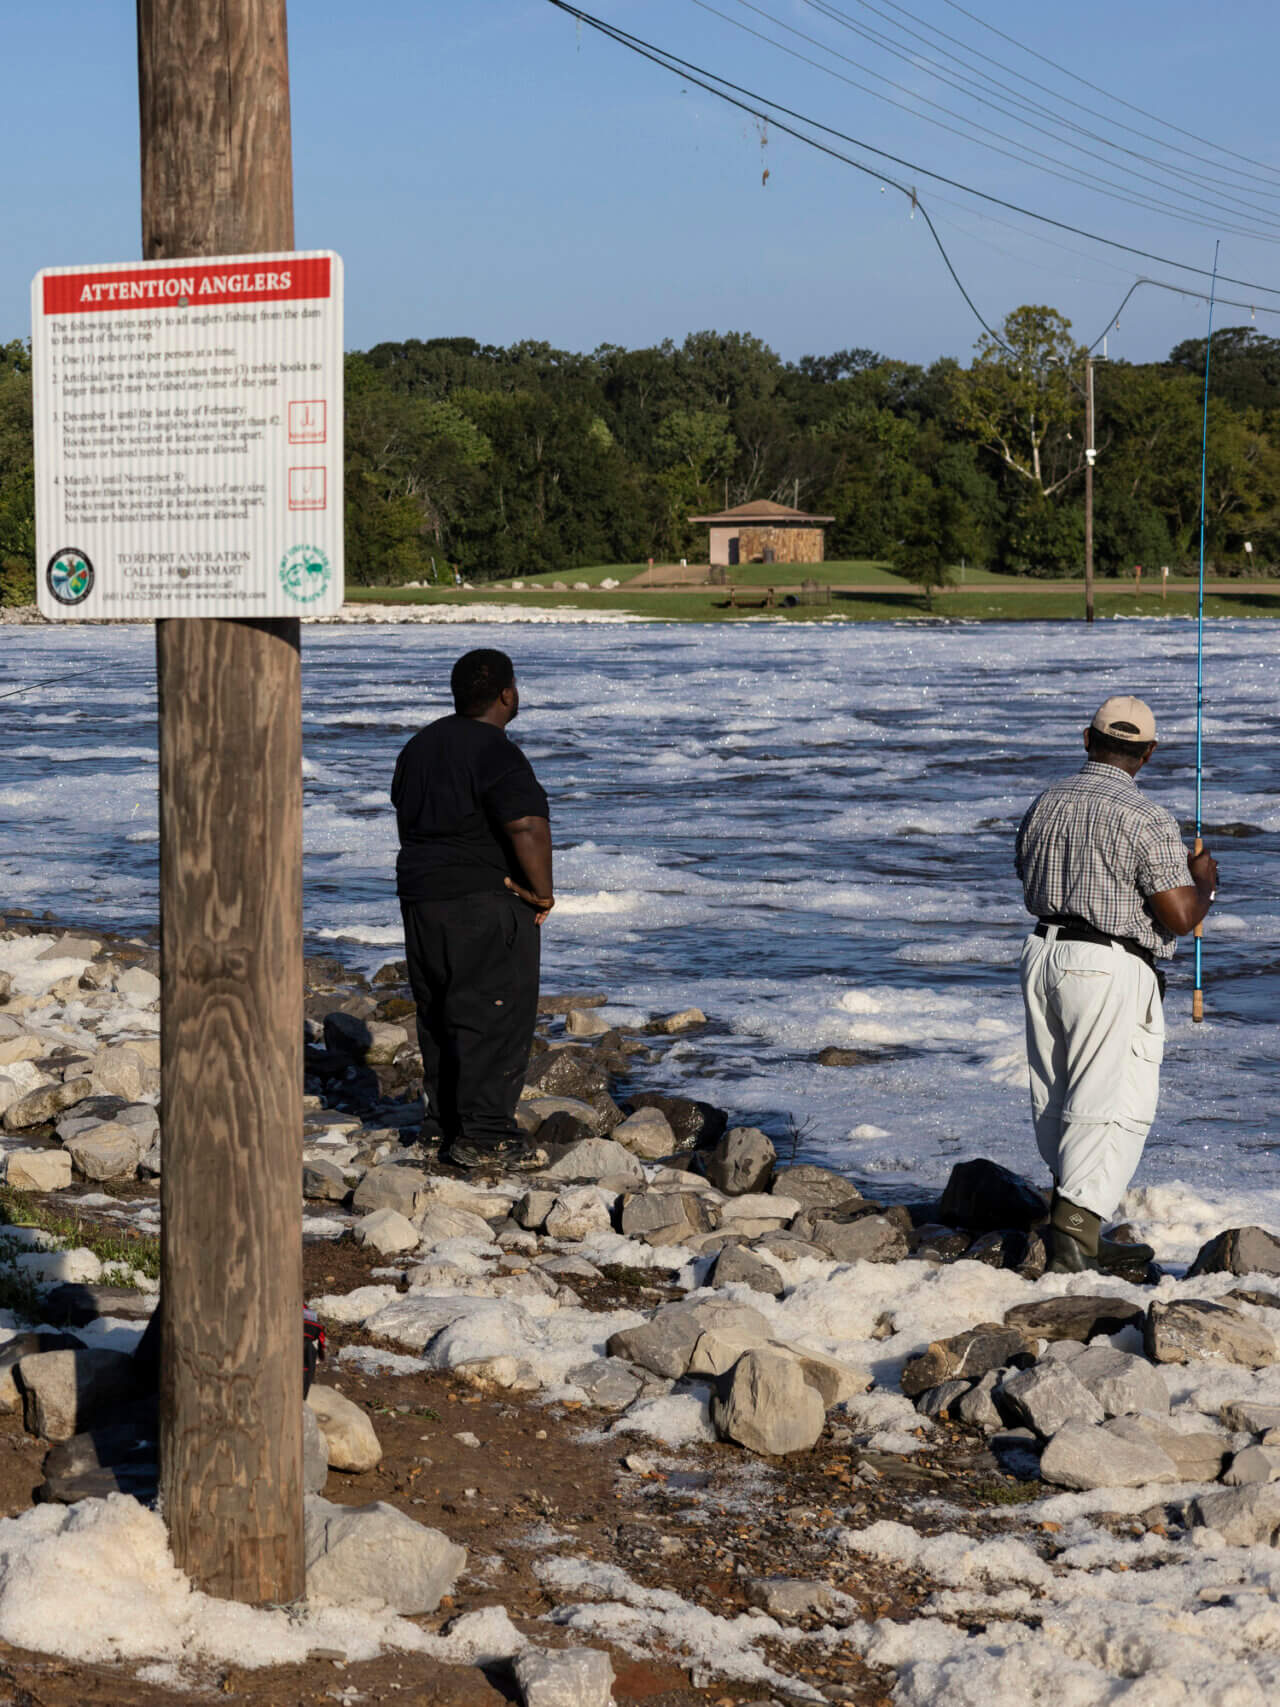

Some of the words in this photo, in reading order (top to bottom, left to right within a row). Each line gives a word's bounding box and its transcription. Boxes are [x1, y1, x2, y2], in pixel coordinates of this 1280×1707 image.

[79, 278, 195, 302] ATTENTION
[198, 271, 292, 295] ANGLERS
[51, 322, 68, 333] The
[70, 320, 112, 332] following
[114, 318, 136, 329] rules
[138, 317, 163, 330] apply
[176, 315, 188, 326] all
[190, 314, 223, 327] anglers
[225, 312, 258, 324] fishing
[259, 311, 282, 321] from
[284, 309, 299, 320] the
[301, 308, 321, 319] dam
[62, 334, 75, 345] the
[77, 333, 94, 344] end
[107, 331, 121, 342] the
[123, 330, 135, 343] rip
[62, 354, 79, 365] One
[82, 353, 96, 366] (1)
[97, 352, 116, 365] pole
[130, 350, 145, 361] rod
[147, 352, 162, 363] per
[164, 350, 194, 362] person
[62, 372, 101, 384] Artificial
[127, 369, 147, 380] with
[188, 367, 208, 377] than
[210, 366, 233, 376] three
[251, 363, 278, 374] treble
[280, 362, 307, 373] hooks
[62, 386, 87, 399] larger
[90, 385, 109, 395] than
[124, 385, 143, 395] may
[188, 382, 204, 392] any
[206, 379, 227, 389] time
[242, 377, 256, 388] the
[63, 410, 107, 422] December
[117, 408, 137, 419] until
[138, 408, 153, 418] the
[155, 407, 171, 418] last
[173, 407, 190, 419] day
[100, 422, 120, 433] than
[121, 423, 136, 432] two
[138, 421, 151, 434] (2)
[180, 419, 205, 429] hooks
[221, 418, 245, 430] larger
[247, 416, 267, 427] than
[63, 436, 91, 447] Hooks
[93, 436, 114, 446] must
[129, 433, 163, 444] secured
[175, 432, 196, 443] least
[197, 434, 214, 442] one
[216, 430, 237, 441] inch
[111, 448, 137, 459] baited
[139, 447, 165, 458] treble
[167, 446, 193, 457] hooks
[196, 448, 210, 456] are
[64, 474, 92, 485] March
[102, 473, 122, 484] until
[124, 472, 171, 483] November
[103, 486, 123, 497] than
[125, 487, 141, 496] two
[143, 485, 157, 498] (2)
[187, 484, 214, 494] hooks
[228, 485, 245, 495] any
[64, 500, 92, 510] Hooks
[94, 501, 116, 510] must
[130, 498, 164, 509] secured
[177, 498, 197, 508] least
[199, 500, 215, 508] one
[217, 497, 237, 507] inch
[112, 511, 138, 522] baited
[140, 511, 166, 521] treble
[168, 510, 194, 521] hooks
[134, 553, 175, 564] REPORT
[190, 551, 251, 563] VIOLATION
[204, 565, 243, 576] SMART
